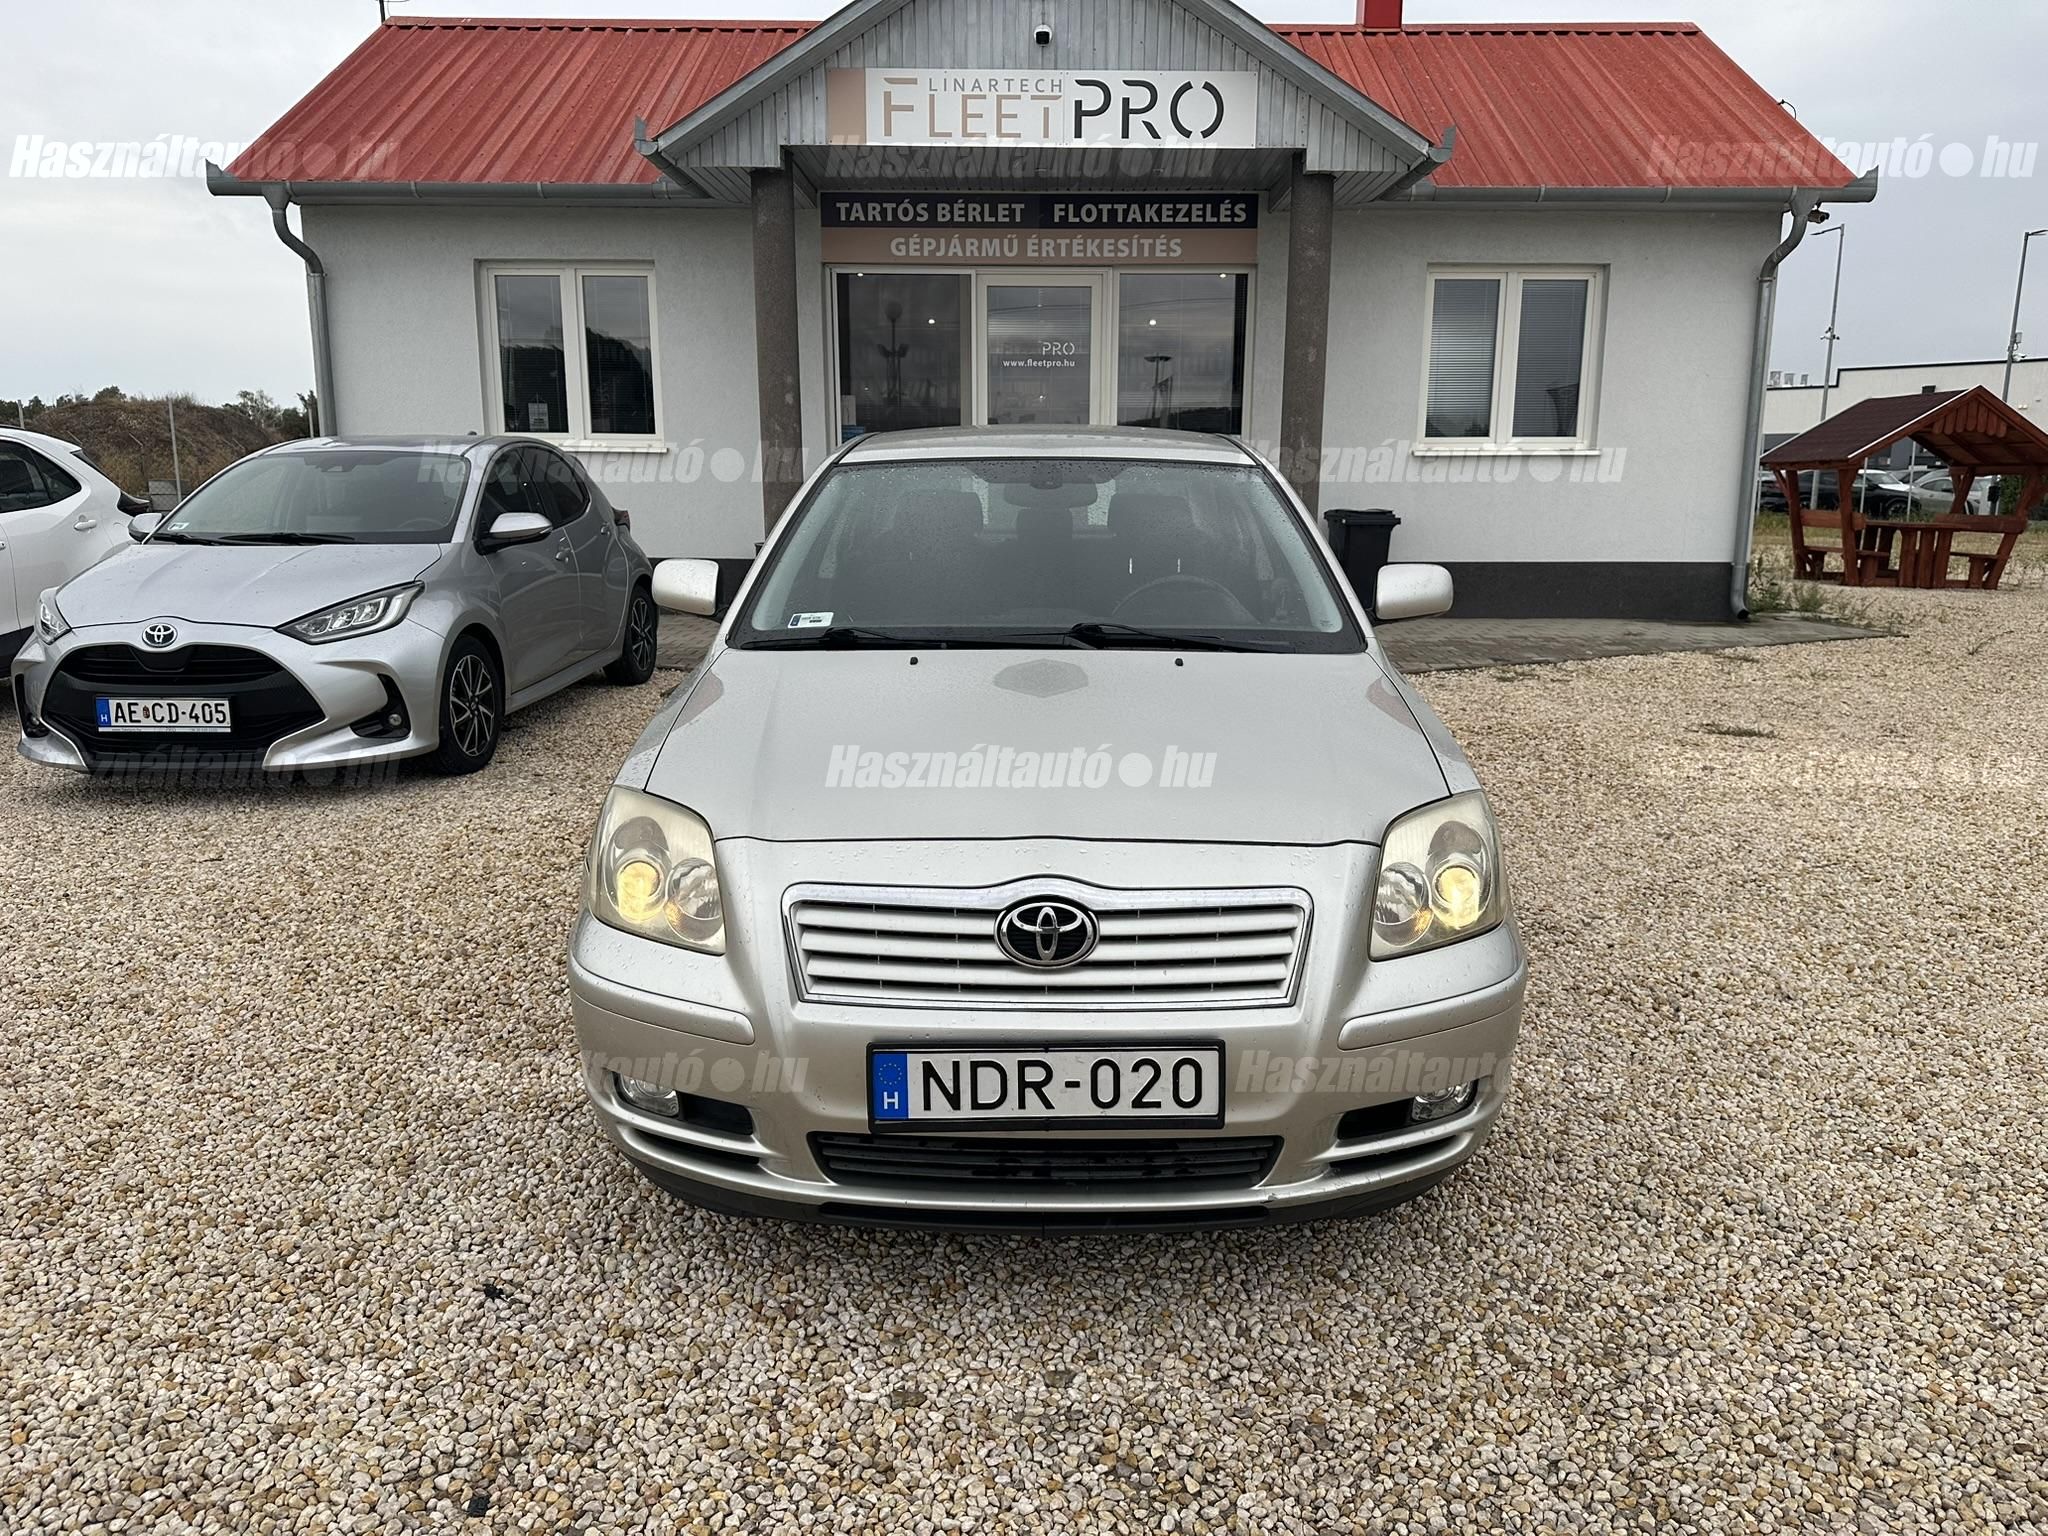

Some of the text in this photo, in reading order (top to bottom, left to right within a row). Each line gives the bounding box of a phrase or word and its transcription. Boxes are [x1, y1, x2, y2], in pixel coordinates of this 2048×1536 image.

[929, 78, 1062, 93] LINARTECH
[836, 199, 1247, 223] TARTÓS BÉRLET FLOTTAKEZELÉS
[890, 234, 1182, 257] GÉPJÁRMŰ ÉRTÉKESÍTÉS
[1003, 359, 1075, 368] www.fleetpro.hu
[101, 714, 108, 722] H
[114, 702, 226, 724] AE CD-405
[921, 1057, 1203, 1111] NDR-020
[883, 1091, 898, 1109] H
